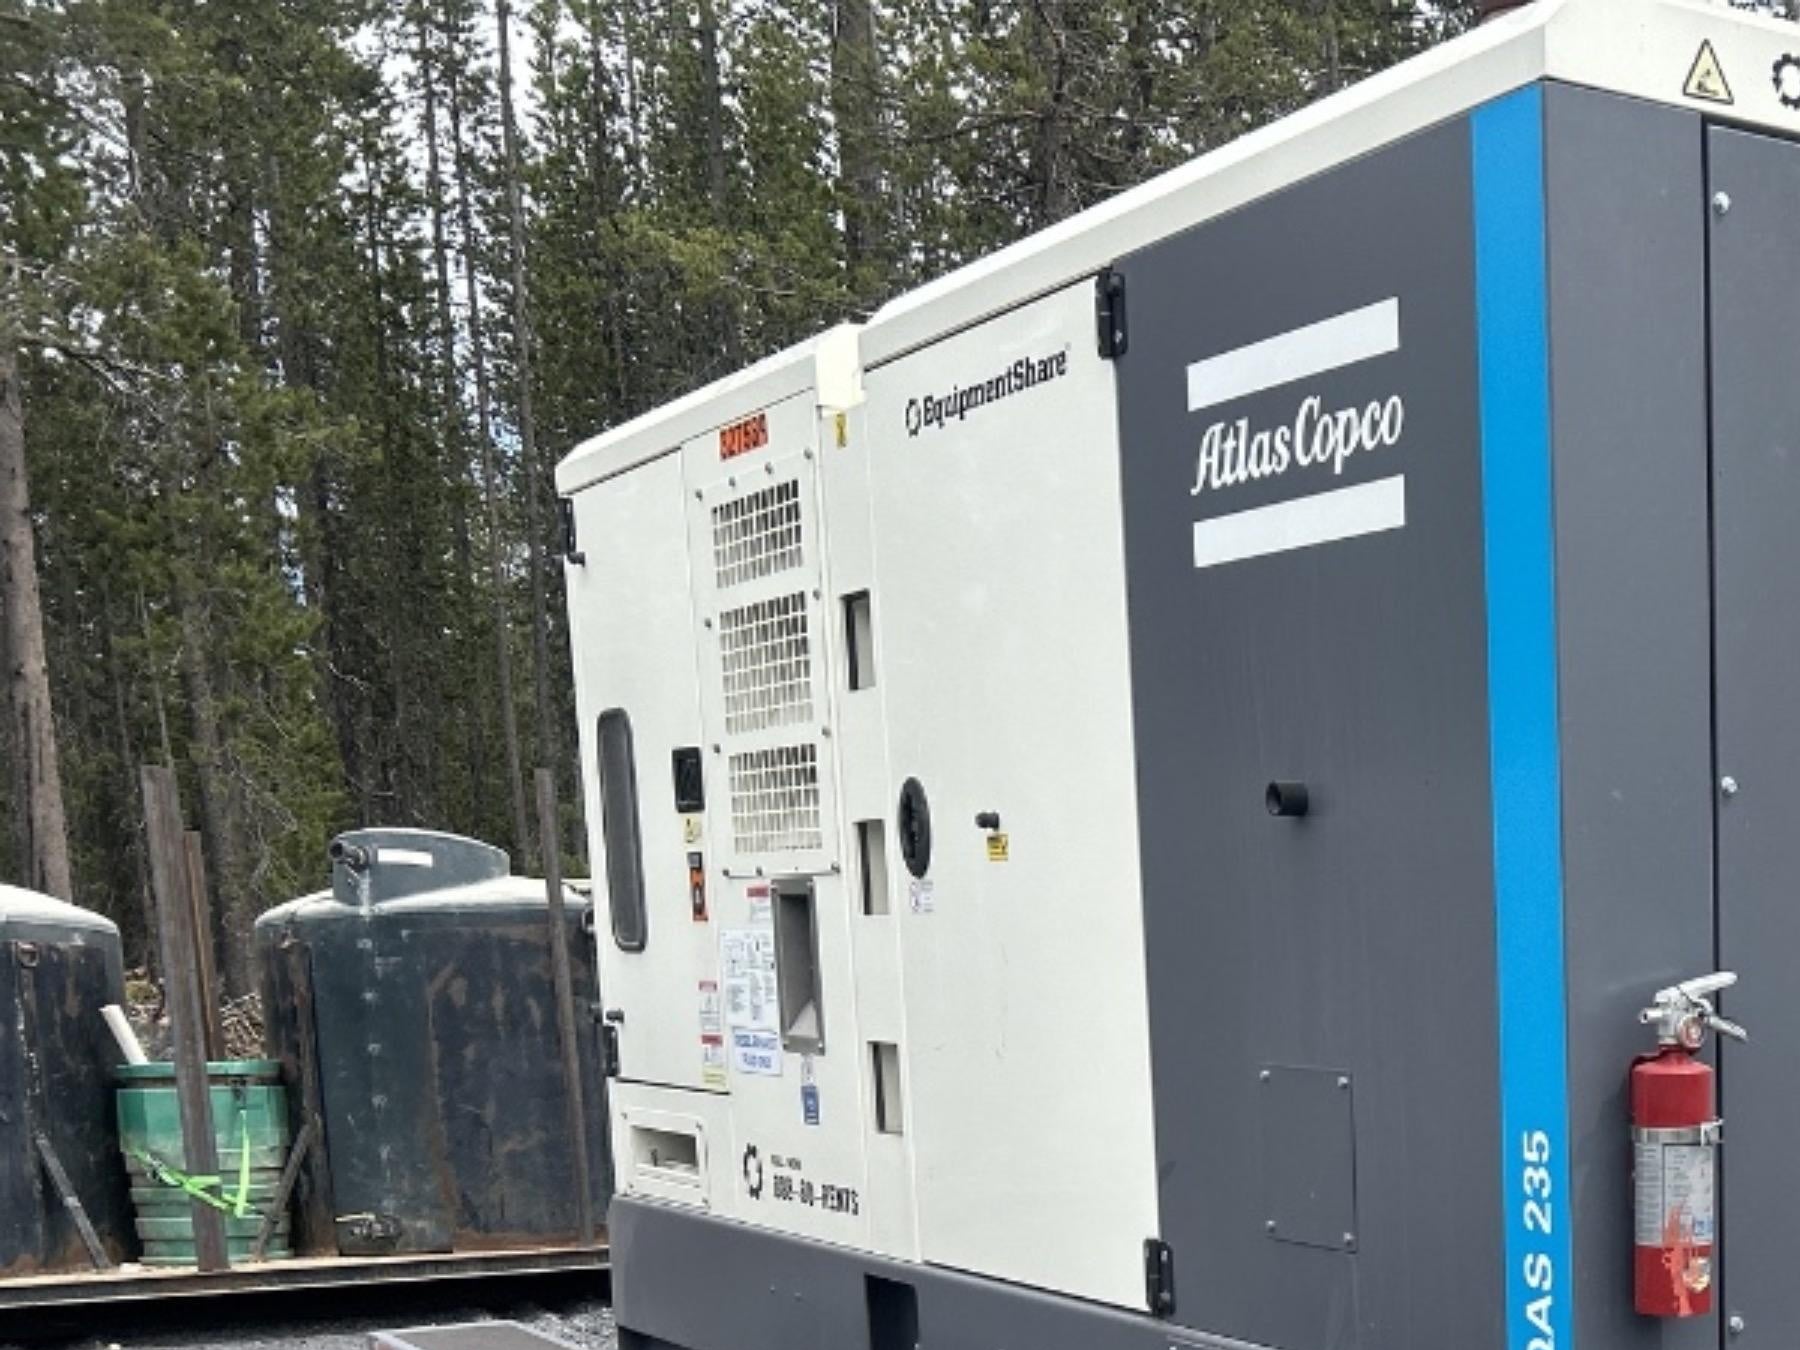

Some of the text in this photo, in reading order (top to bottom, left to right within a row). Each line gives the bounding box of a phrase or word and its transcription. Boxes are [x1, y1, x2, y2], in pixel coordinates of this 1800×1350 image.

[923, 350, 1067, 429] EquipmentShare
[1190, 395, 1404, 496] Atlas Copco
[1522, 1130, 1553, 1235] 235
